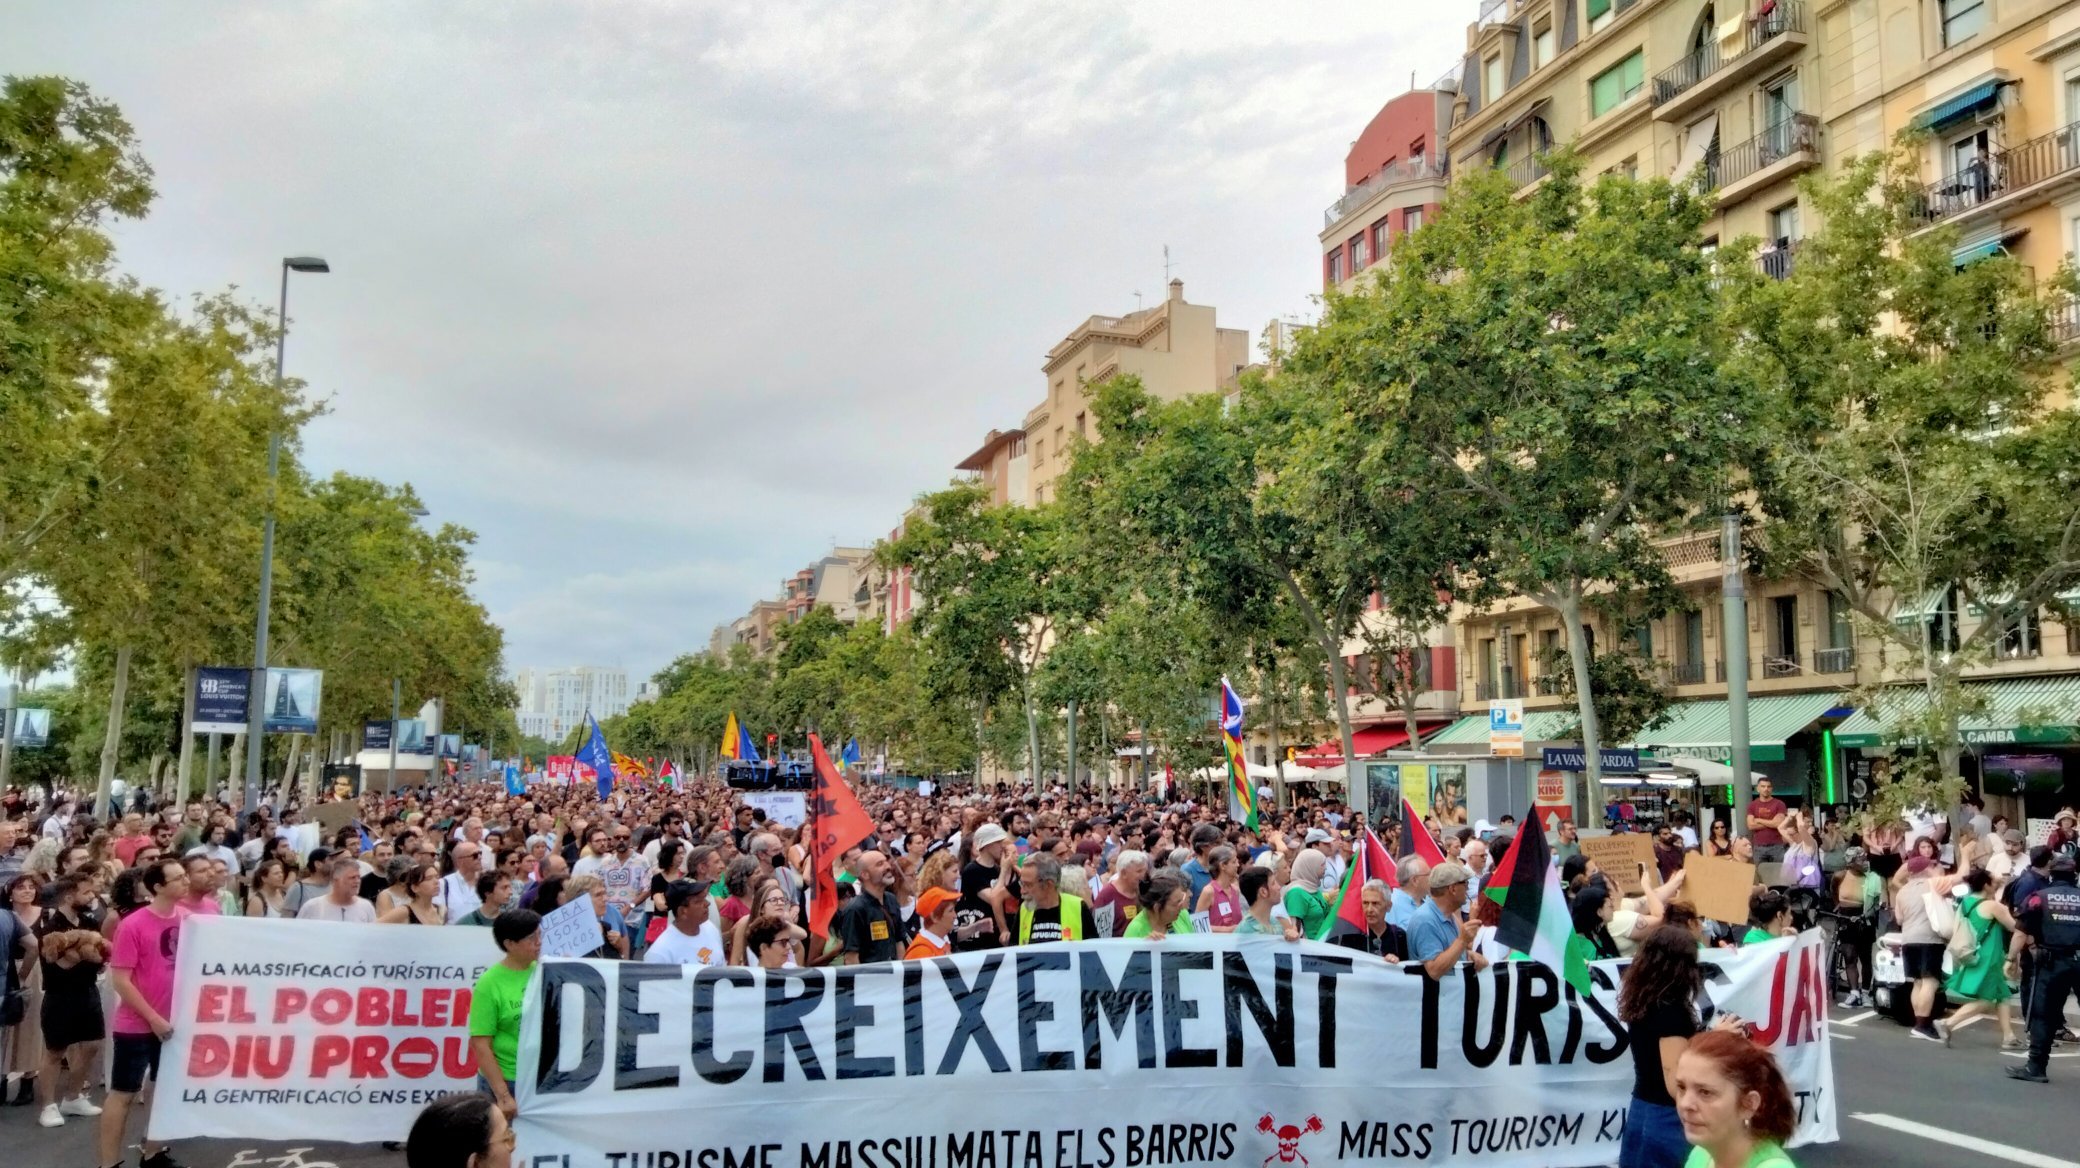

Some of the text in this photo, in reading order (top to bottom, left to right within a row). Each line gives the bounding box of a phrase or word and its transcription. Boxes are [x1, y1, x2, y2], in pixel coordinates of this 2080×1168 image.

[1494, 710, 1504, 723] P
[1547, 753, 1635, 768] LA VANARDIA
[1537, 785, 1564, 796] KING
[546, 928, 596, 957] STICOS
[201, 960, 488, 981] LA MASSIFICACIÓ TURÍSTICA E
[195, 984, 256, 1024] EL
[536, 943, 1824, 1095] DECREIXEMENT TURIS JA!
[187, 1034, 479, 1080] DIU PROU
[182, 1088, 207, 1105] LA
[214, 1084, 362, 1105] GENTRIFICACIÓ
[369, 1090, 405, 1105] ENS
[947, 1129, 1043, 1168] MATA
[1055, 1126, 1115, 1168] ELS
[1125, 1121, 1239, 1168] BARRIS
[1338, 1119, 1434, 1160] MASS
[1451, 1111, 1585, 1156] TOURISM
